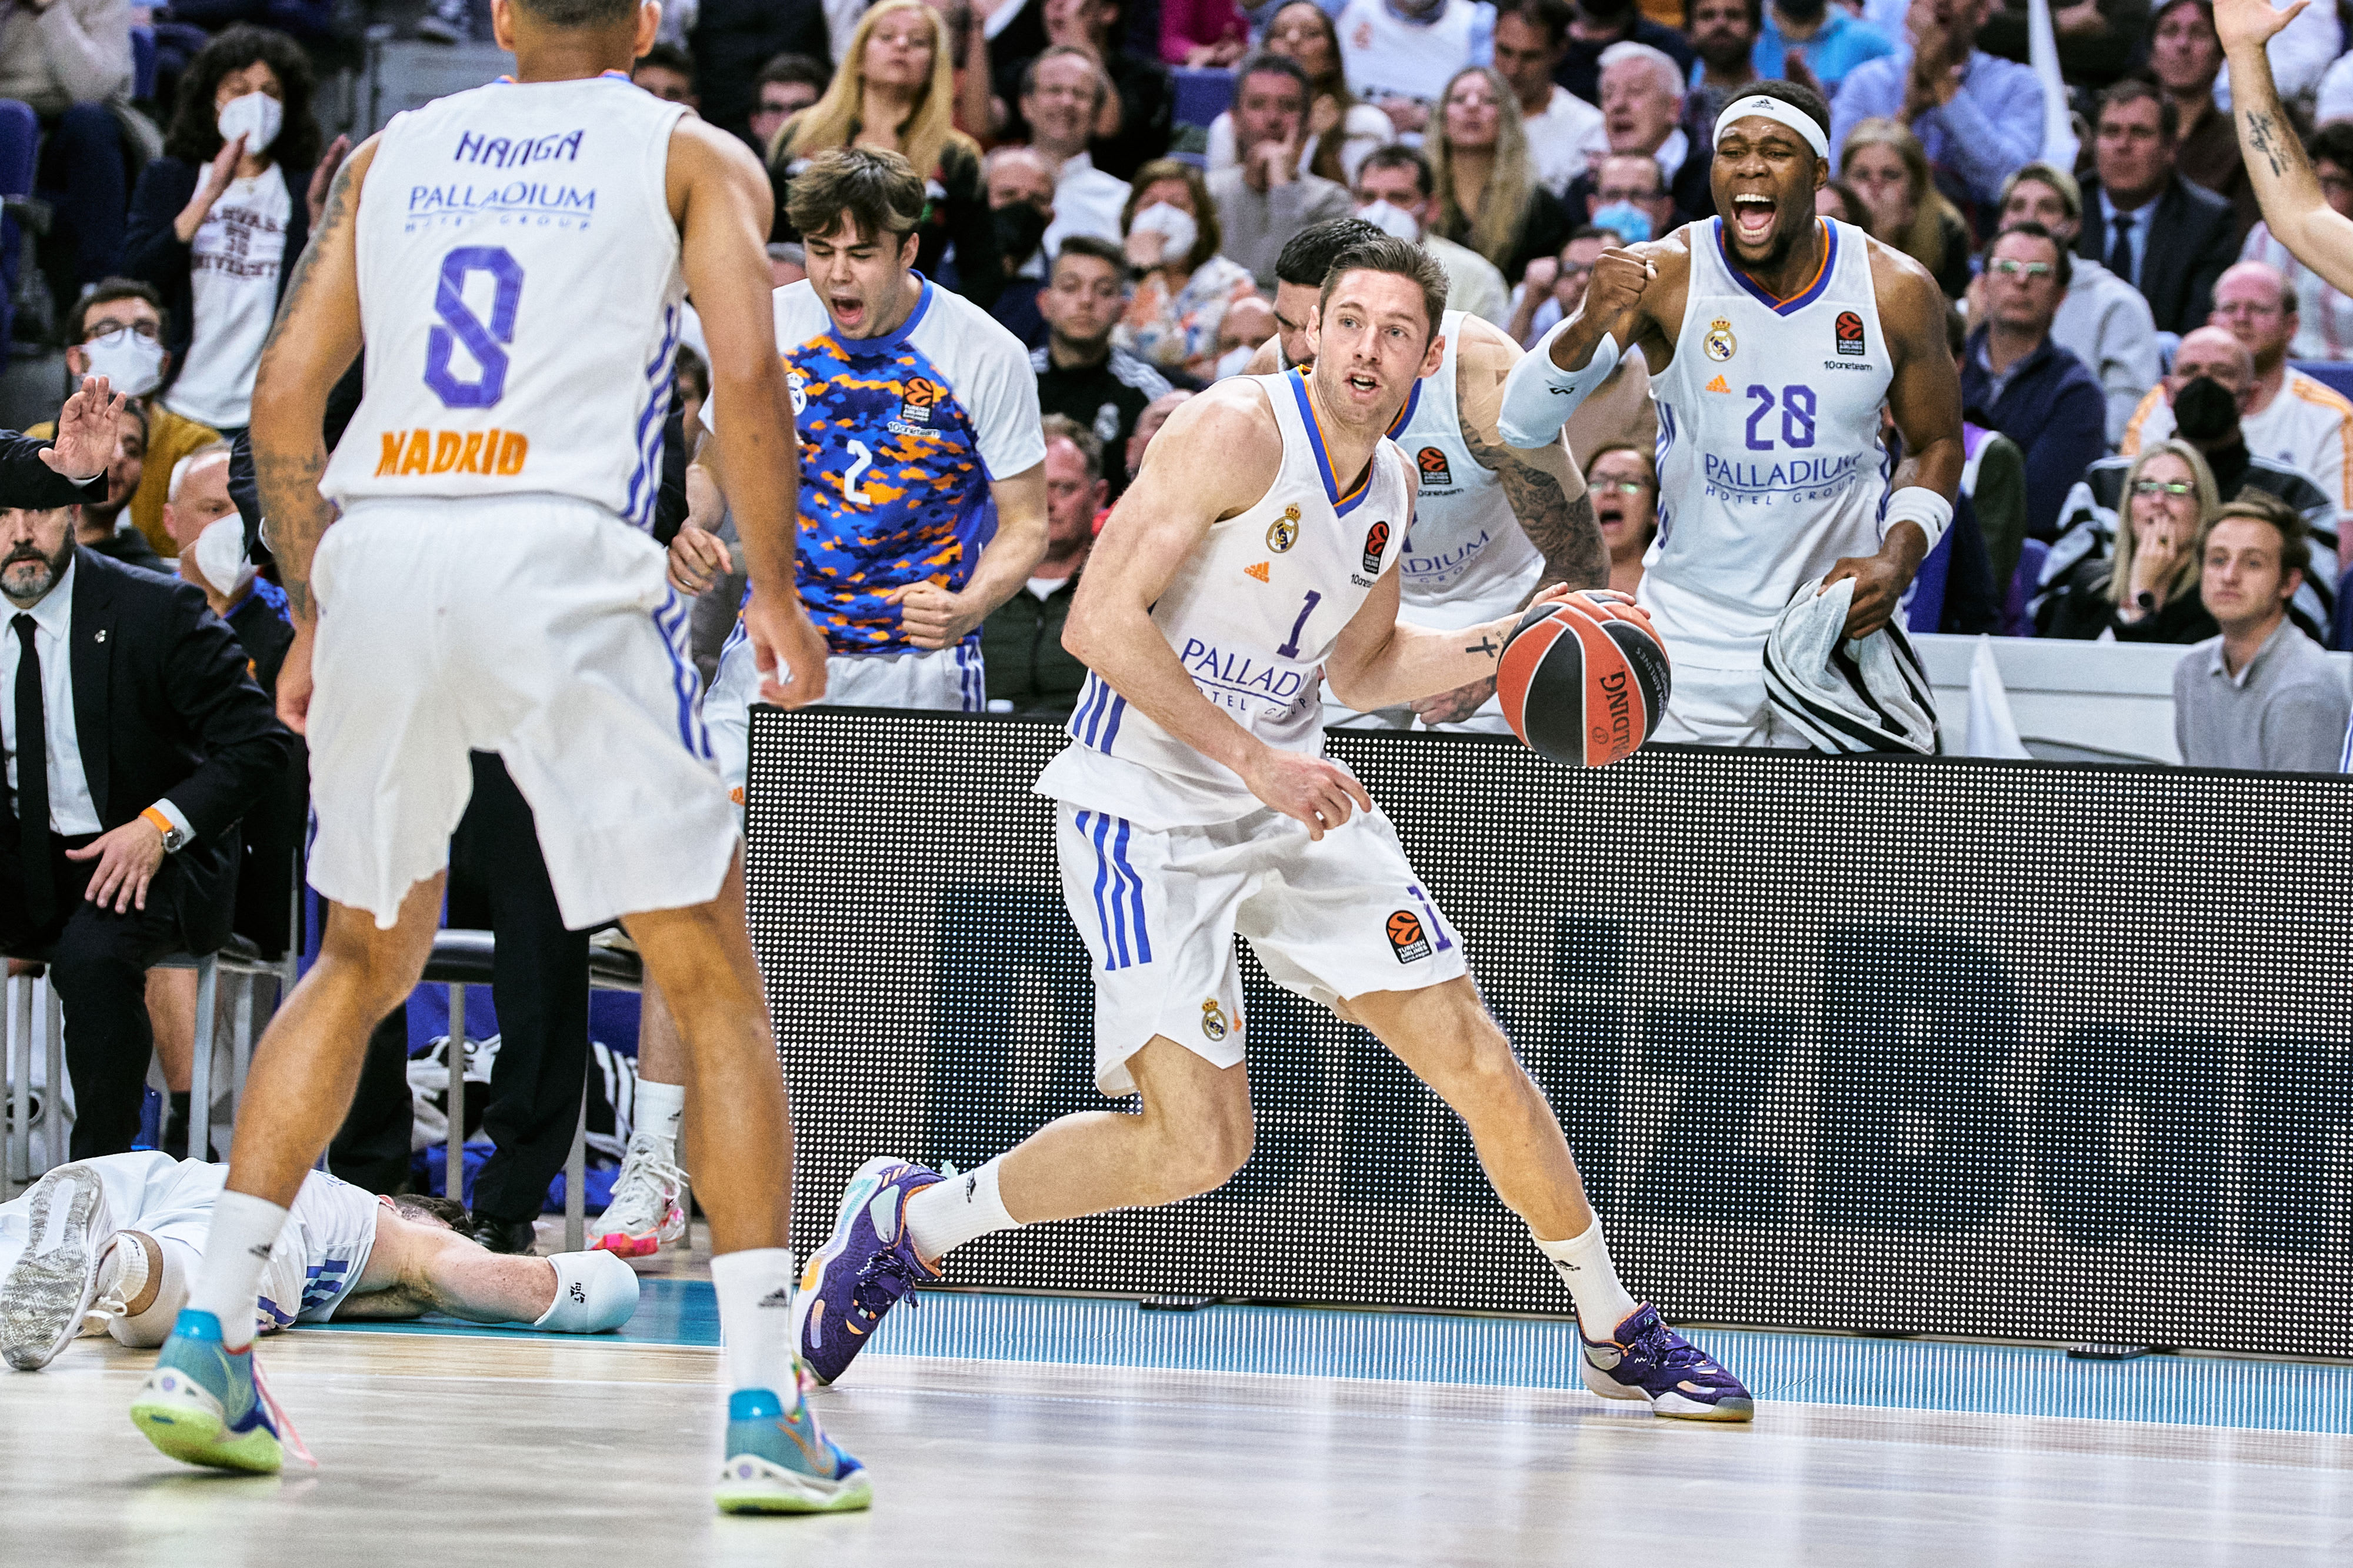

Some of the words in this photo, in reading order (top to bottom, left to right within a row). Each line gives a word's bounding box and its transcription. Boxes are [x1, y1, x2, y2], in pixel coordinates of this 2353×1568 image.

[408, 181, 596, 210] PALLADIUM
[424, 244, 525, 409] 8
[1745, 384, 1817, 451] 28
[374, 428, 529, 478] MADRID
[844, 439, 872, 505] 2
[1706, 485, 1772, 505] HOTEL
[1277, 589, 1322, 659] 1
[1397, 939, 1426, 953] TURKISH
[1406, 885, 1454, 953] 1
